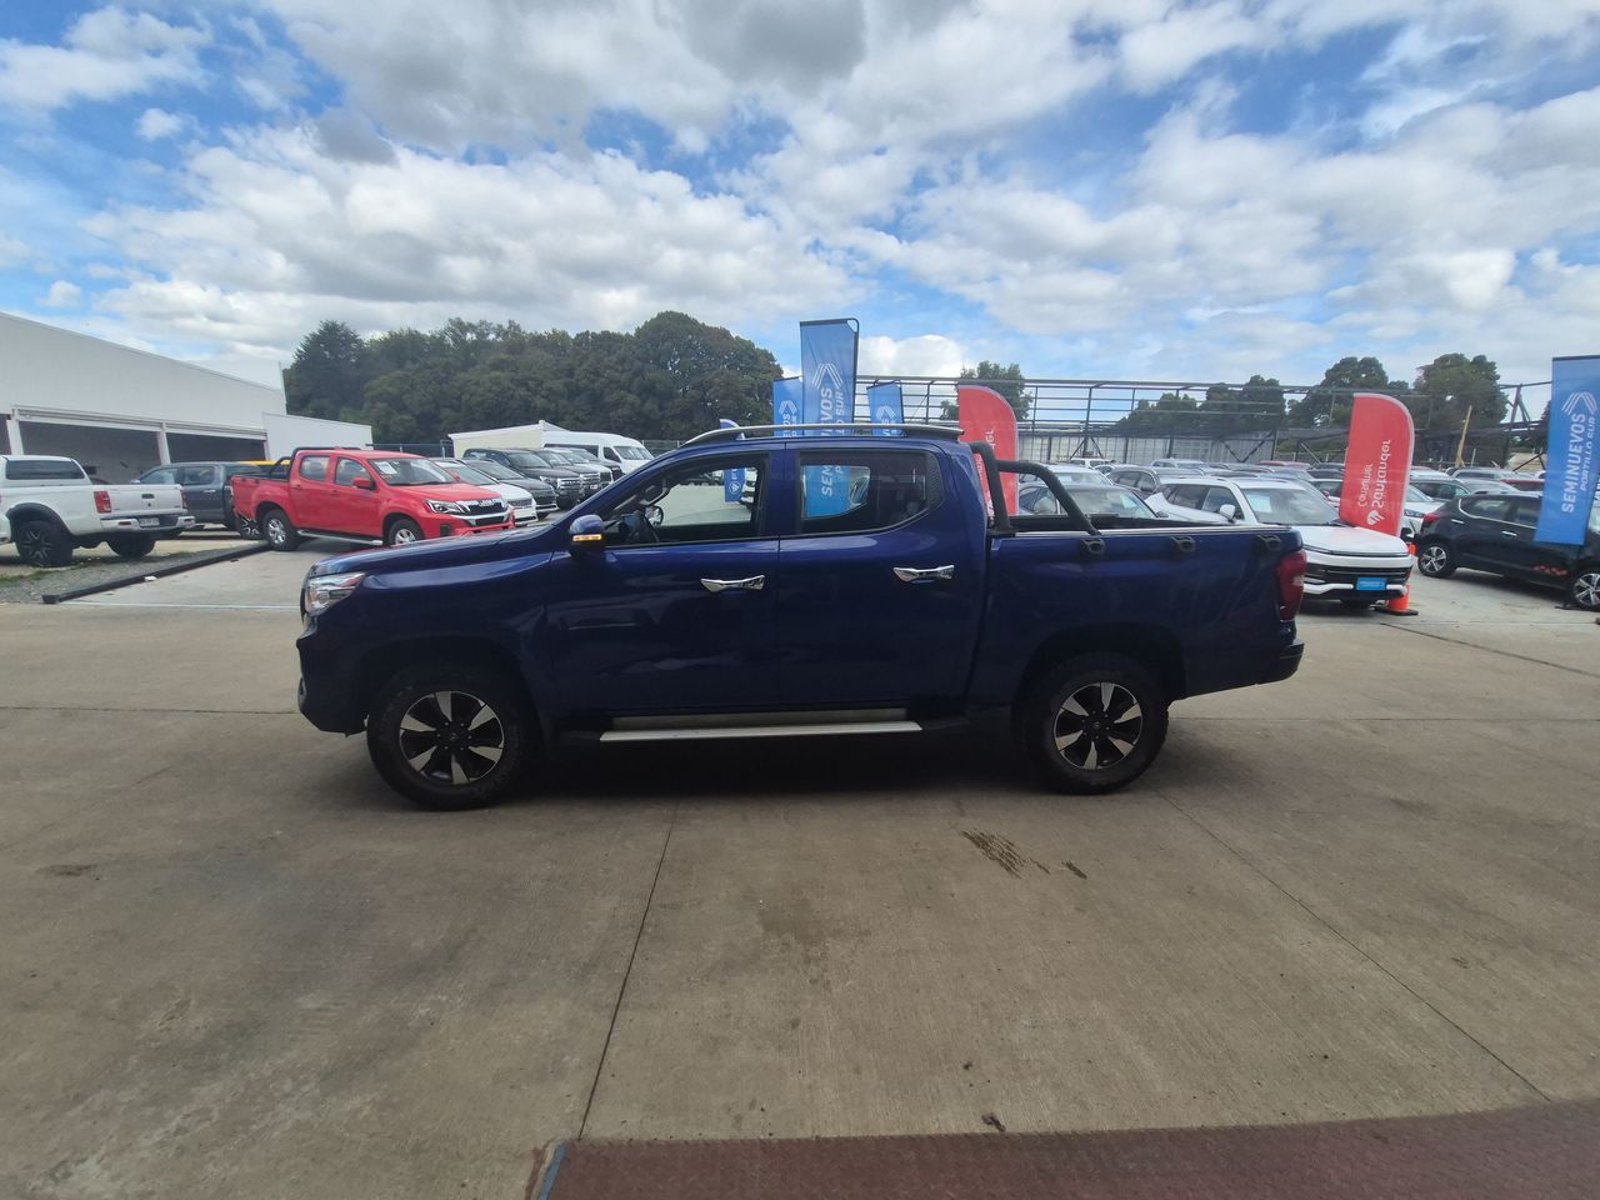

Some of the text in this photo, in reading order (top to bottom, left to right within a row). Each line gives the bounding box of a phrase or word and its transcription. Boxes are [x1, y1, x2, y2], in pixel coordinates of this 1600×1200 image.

[1562, 413, 1586, 513] SEMINUEVOS
[1580, 416, 1596, 492] PORTILLO SUR
